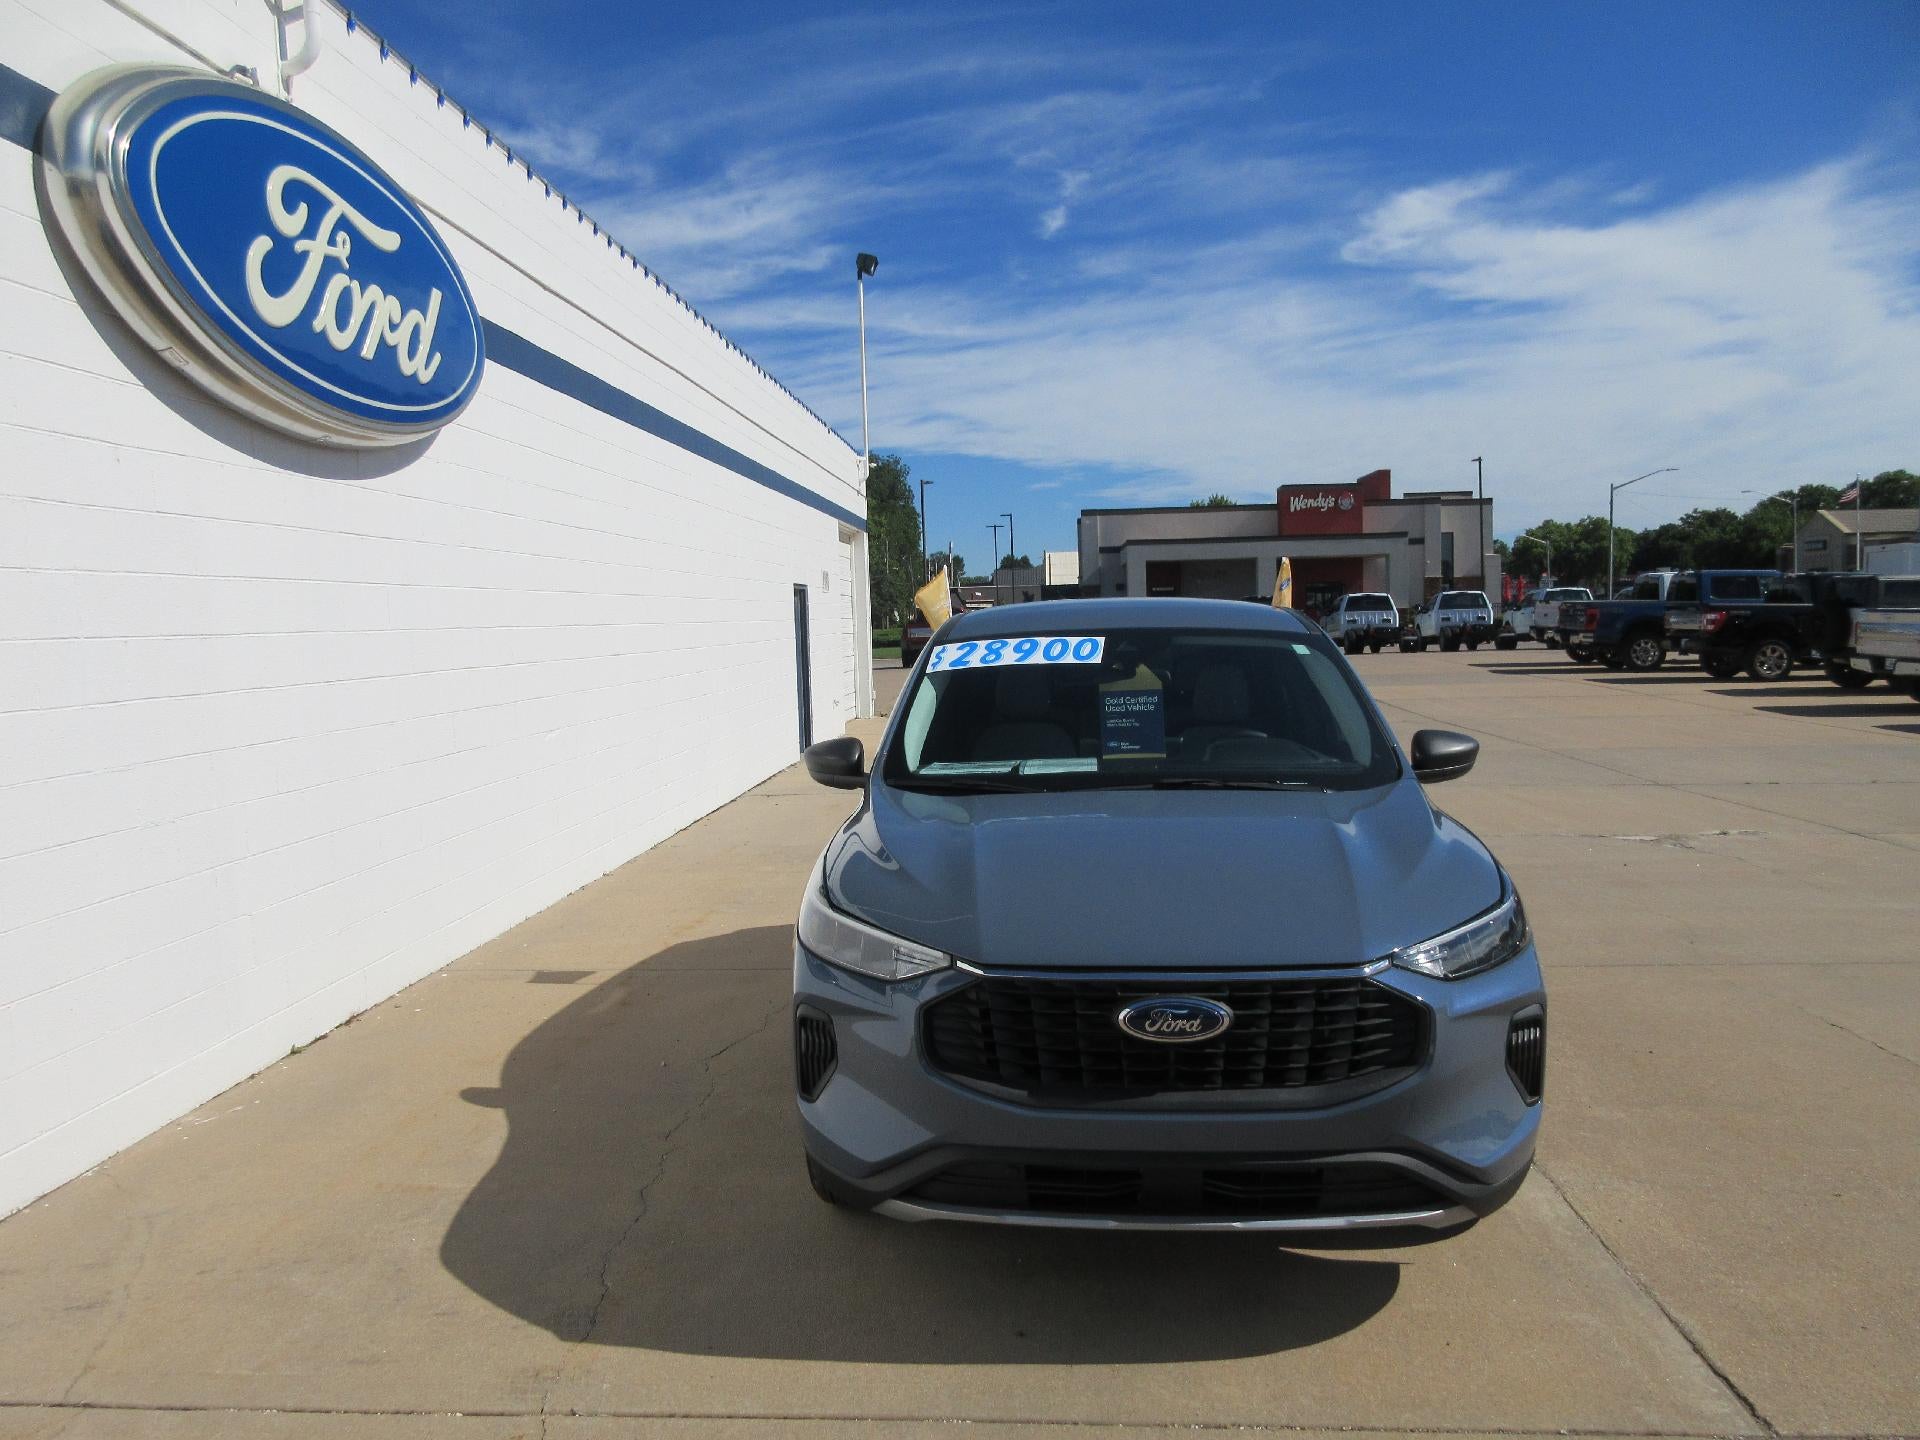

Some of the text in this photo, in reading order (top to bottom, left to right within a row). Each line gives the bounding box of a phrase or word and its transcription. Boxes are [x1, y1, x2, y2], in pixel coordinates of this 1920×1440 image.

[246, 164, 443, 385] Ford
[1290, 492, 1335, 513] Wendy's
[931, 637, 1101, 670] $28900
[1105, 703, 1155, 712] Used Vehicle
[1145, 1008, 1202, 1032] Ford
